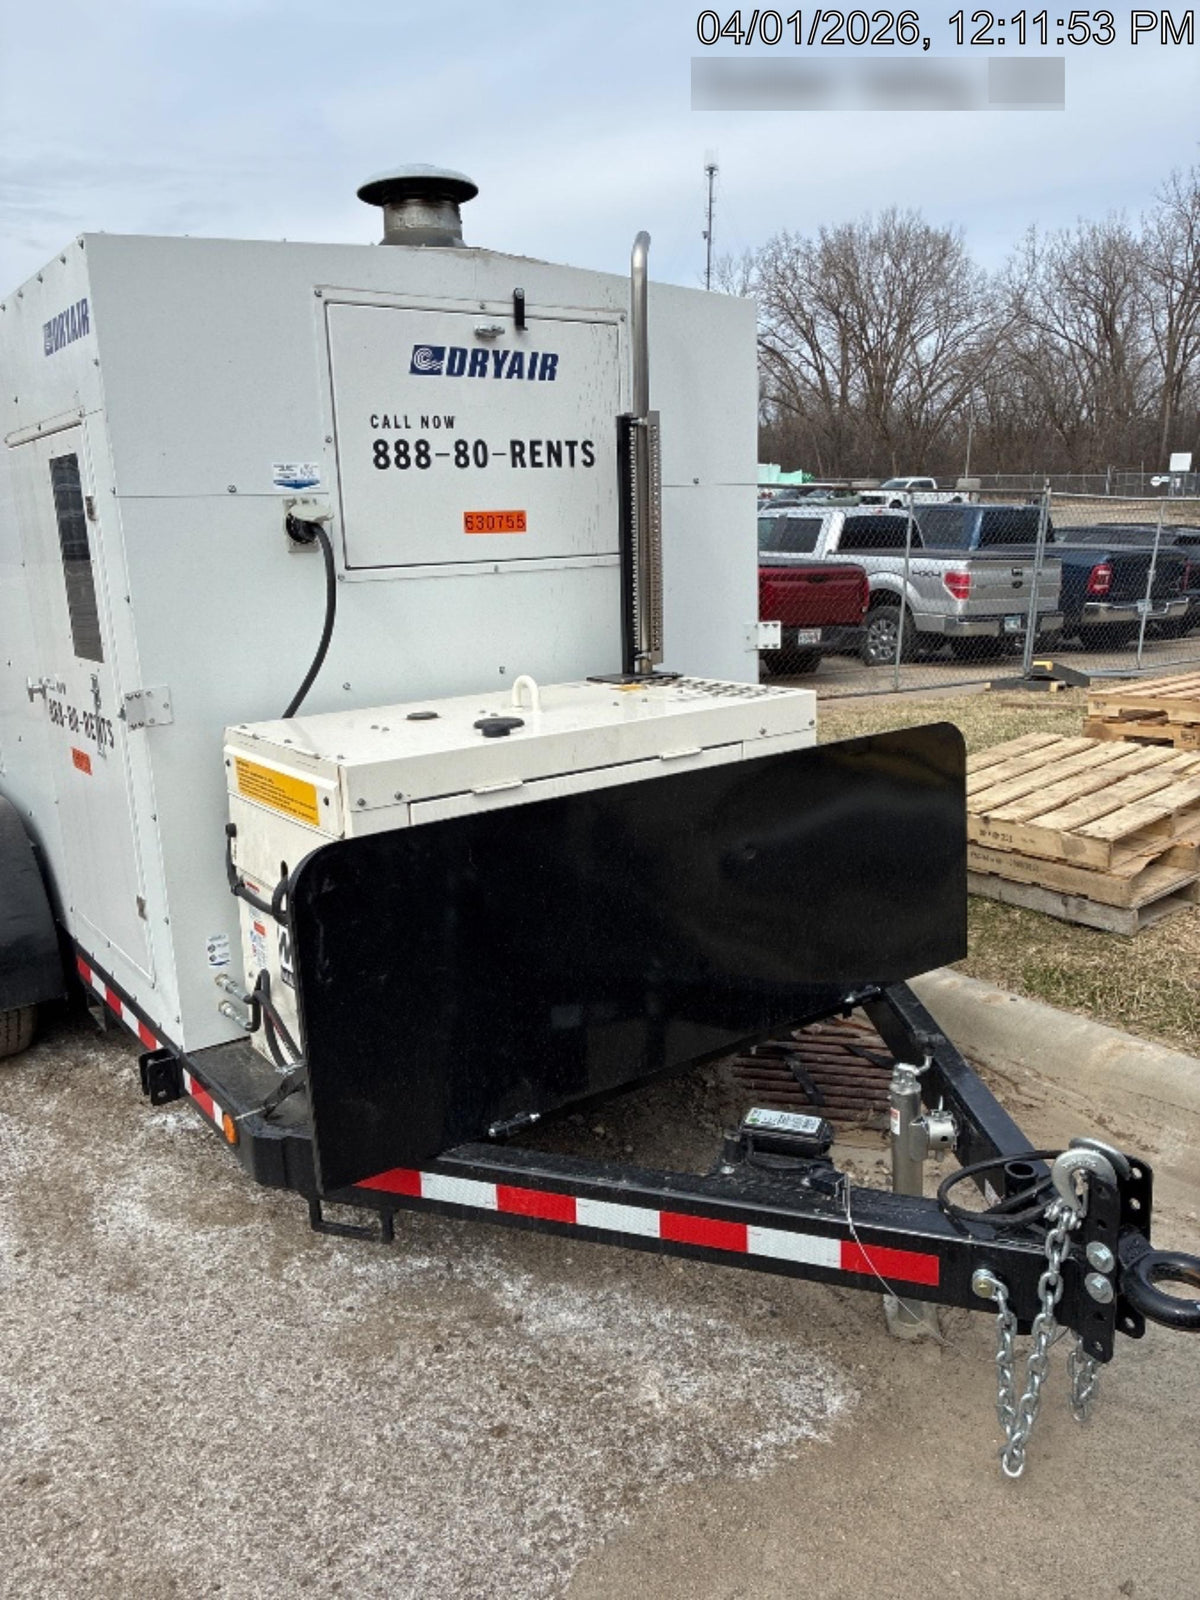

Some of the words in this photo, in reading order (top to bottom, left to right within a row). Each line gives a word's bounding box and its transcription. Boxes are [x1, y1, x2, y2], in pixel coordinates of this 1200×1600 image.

[445, 346, 559, 381] DRYAIR
[370, 414, 412, 430] CALL
[420, 415, 456, 430] NOW
[372, 438, 597, 471] 888-80-RENTS
[465, 514, 526, 531] 630755
